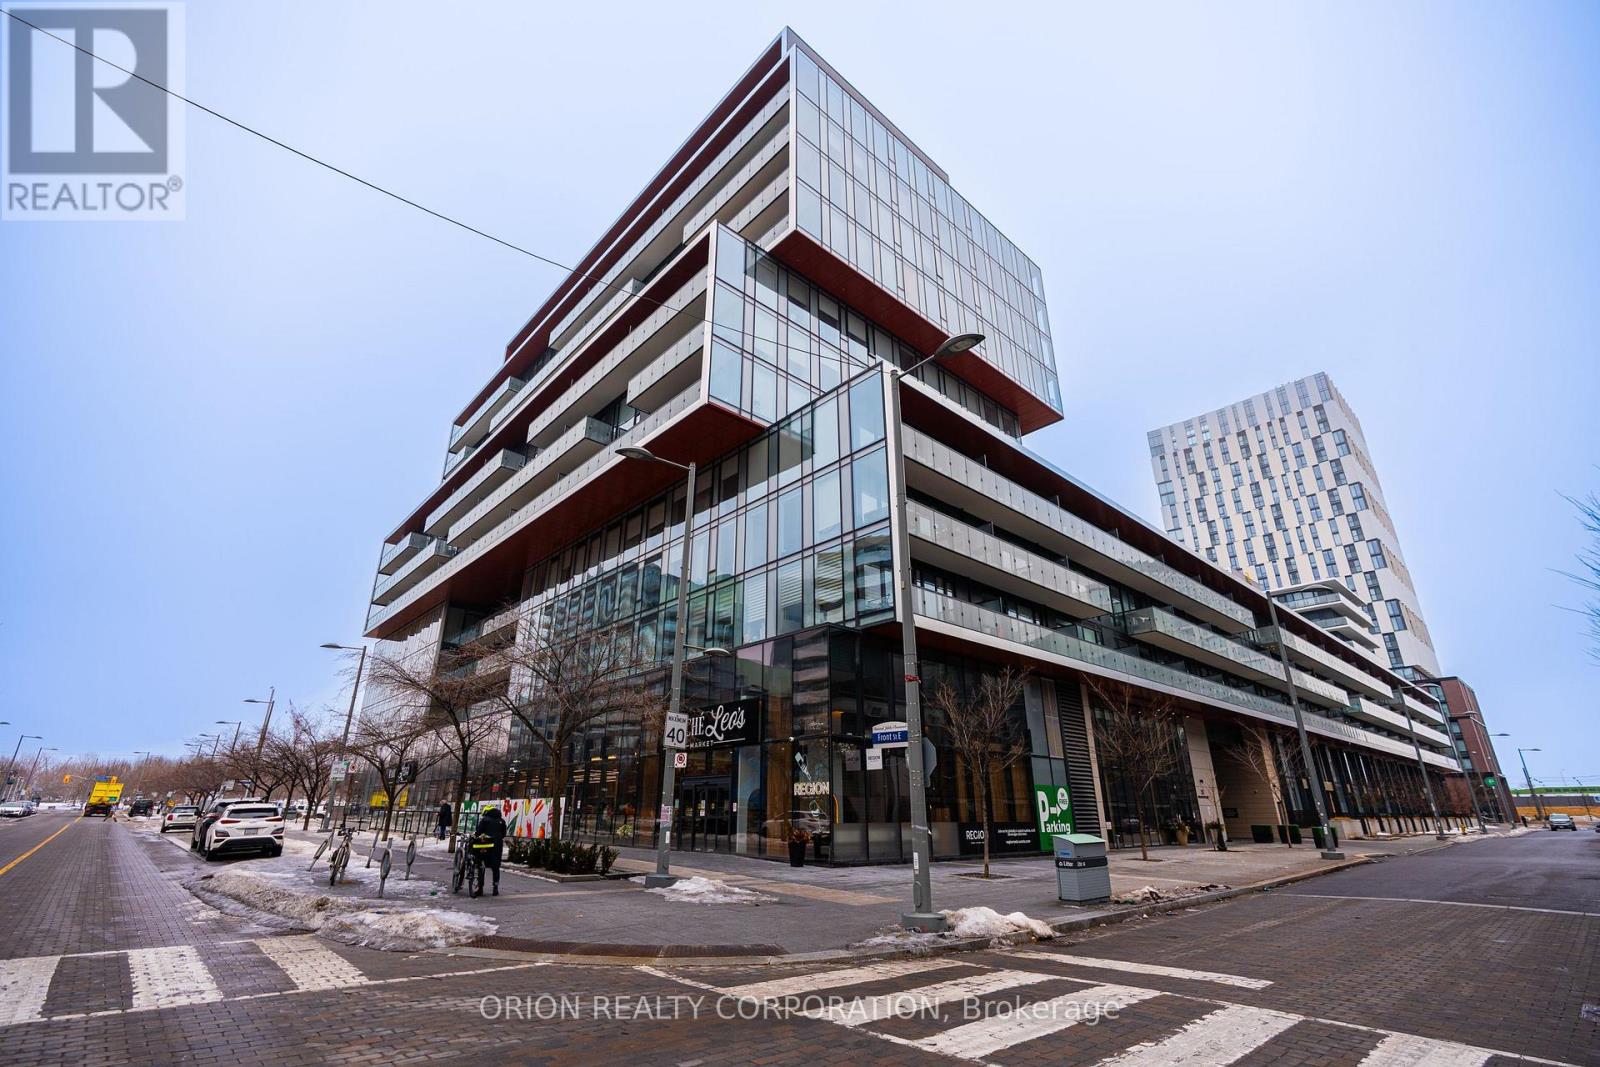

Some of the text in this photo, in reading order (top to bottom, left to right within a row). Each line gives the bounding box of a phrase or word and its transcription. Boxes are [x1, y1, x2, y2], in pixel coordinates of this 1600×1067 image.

[704, 704, 746, 741] Leo's
[666, 727, 685, 744] 40
[877, 733, 892, 742] Front
[897, 731, 902, 740] E
[689, 740, 714, 749] MARKET
[793, 781, 830, 796] REGION
[1037, 790, 1071, 835] Parking
[965, 830, 986, 840] REGIO
